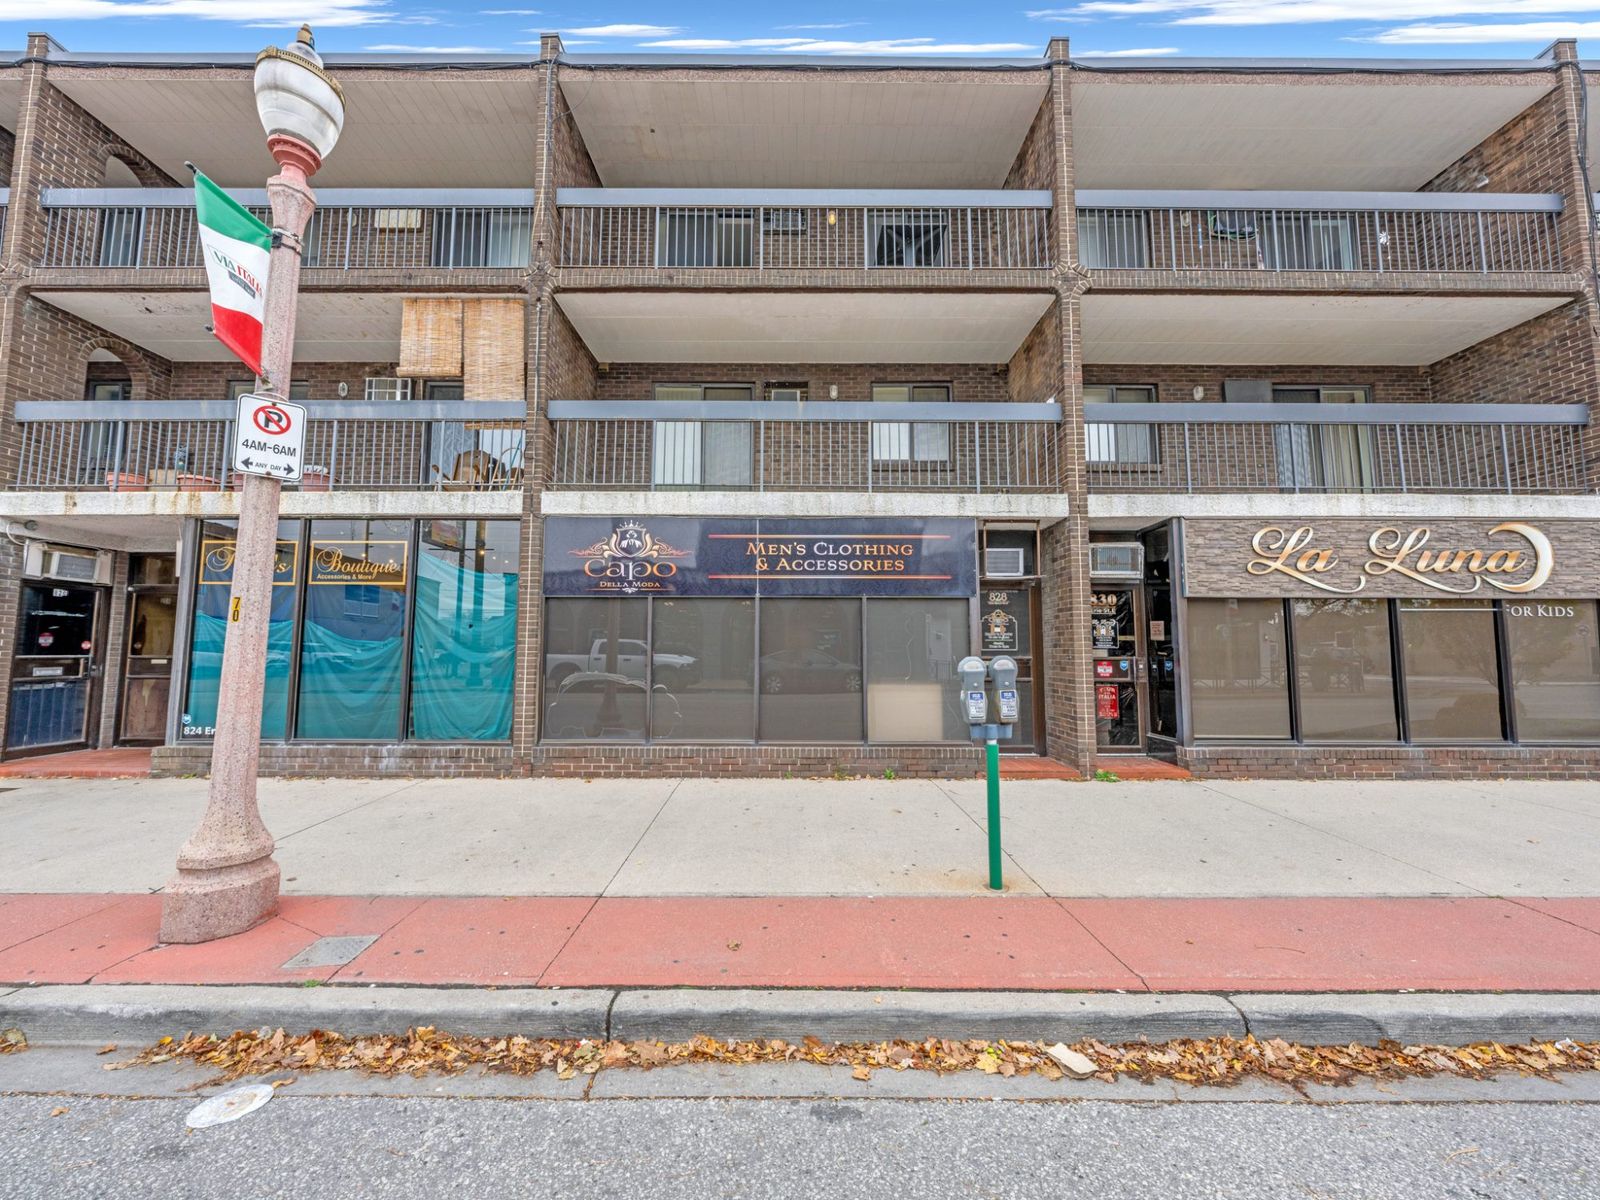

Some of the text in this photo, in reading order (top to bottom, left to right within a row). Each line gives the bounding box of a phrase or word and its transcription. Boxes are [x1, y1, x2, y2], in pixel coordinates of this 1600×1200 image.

[213, 250, 236, 273] VIA
[236, 264, 263, 298] ITALIA
[242, 438, 297, 458] 4AM-6AM
[746, 541, 915, 556] MEN'S CLOTHING
[315, 546, 401, 579] Boutique
[755, 558, 905, 572] & ACCESSORIES
[1246, 526, 1528, 594] La Luna
[989, 592, 1008, 602] 828
[1090, 593, 1117, 606] 830
[1537, 604, 1574, 617] KIDS
[183, 726, 216, 735] 824 Er
